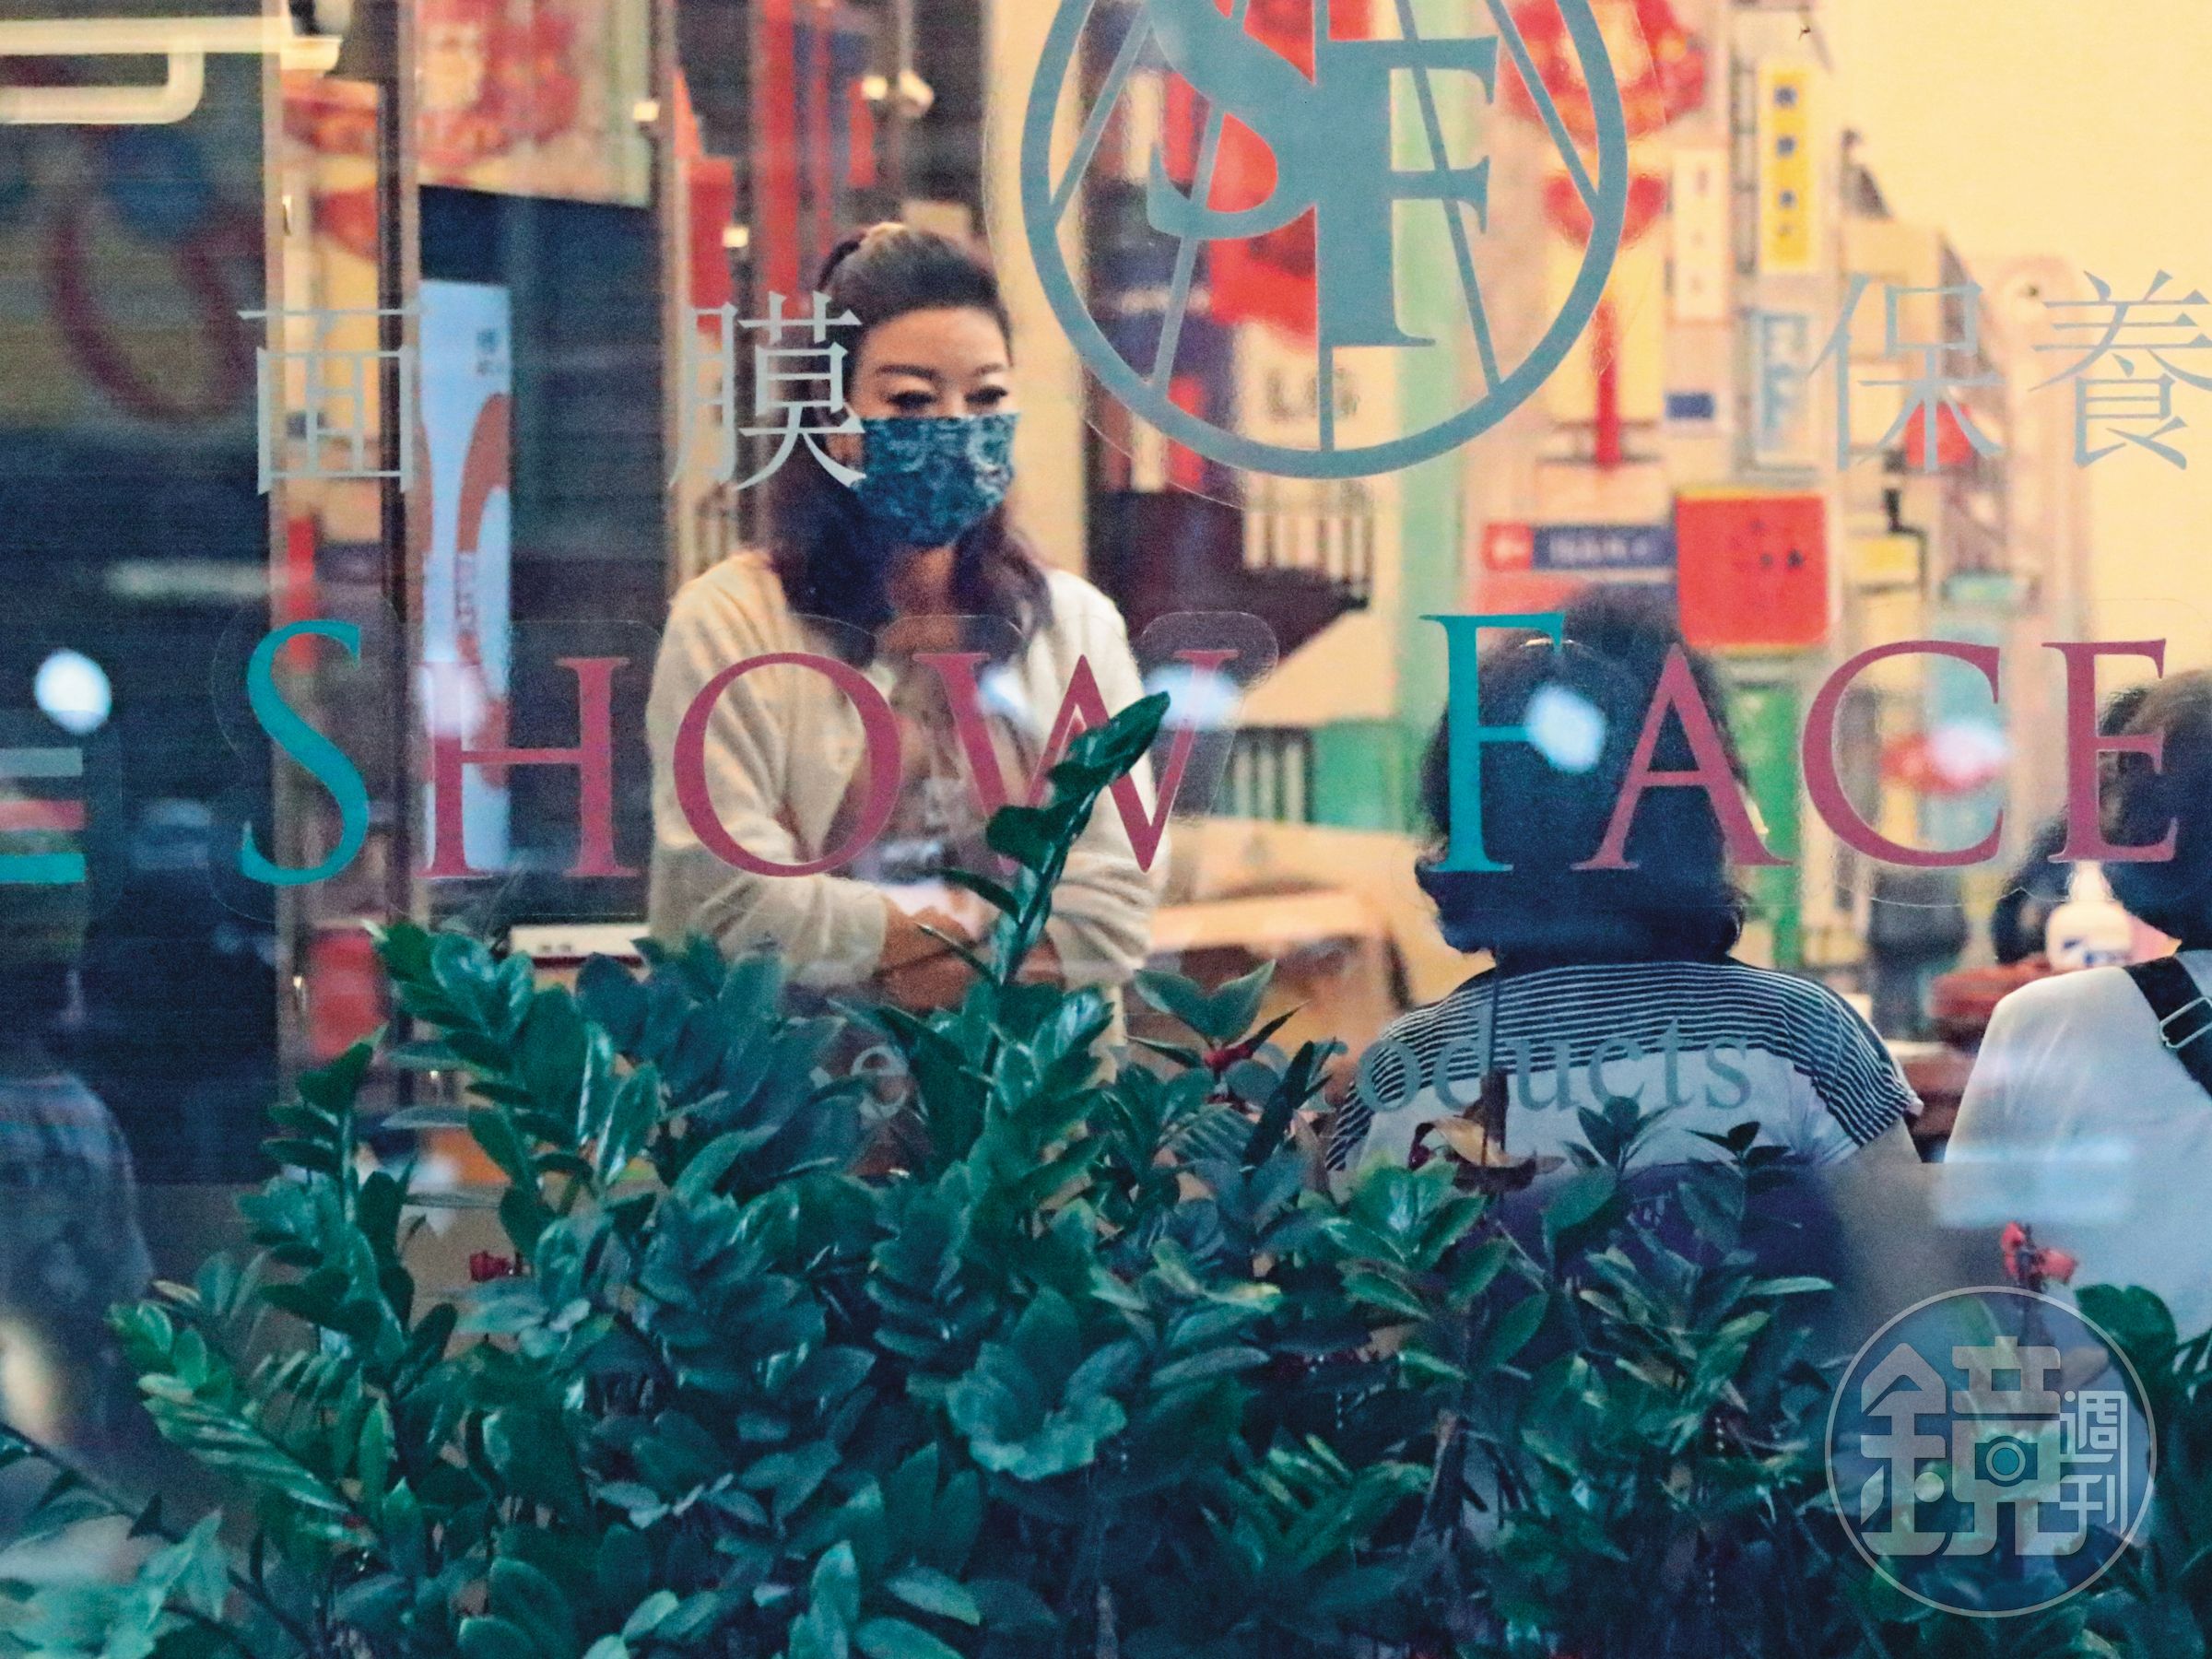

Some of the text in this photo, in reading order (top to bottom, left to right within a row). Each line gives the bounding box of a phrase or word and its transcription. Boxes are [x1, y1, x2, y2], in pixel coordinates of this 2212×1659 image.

[1806, 269, 2212, 474] 保養
[240, 611, 2178, 887] SHOW FACE
